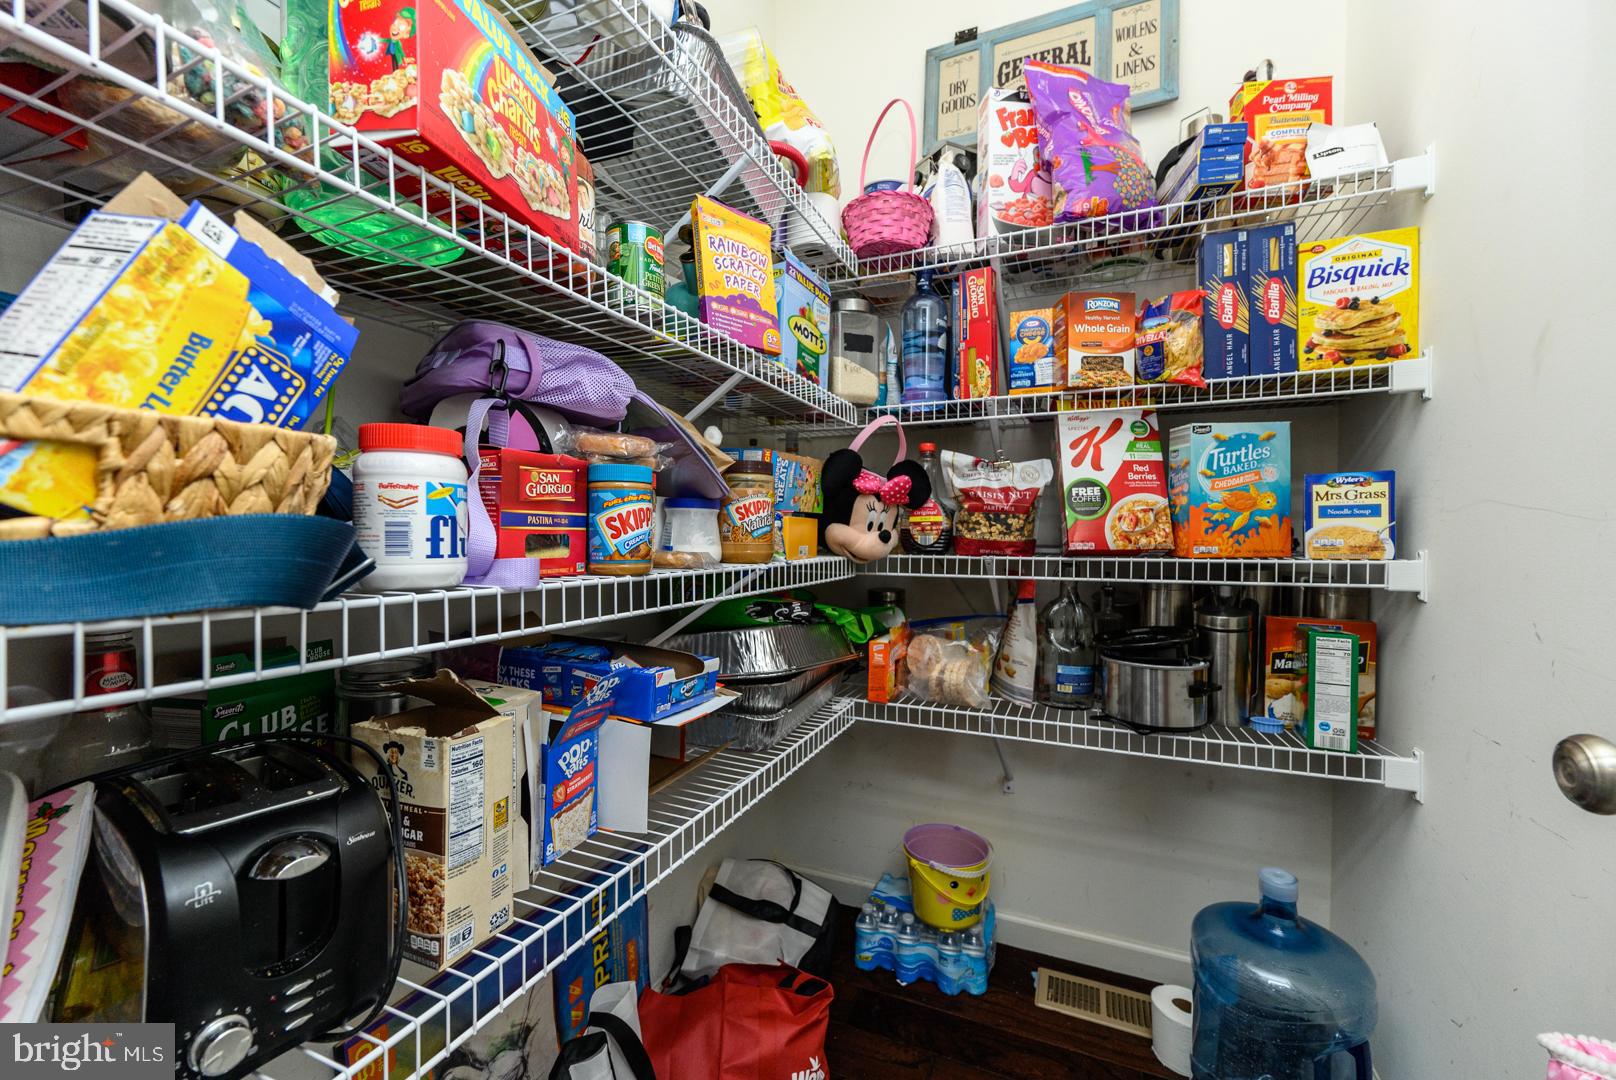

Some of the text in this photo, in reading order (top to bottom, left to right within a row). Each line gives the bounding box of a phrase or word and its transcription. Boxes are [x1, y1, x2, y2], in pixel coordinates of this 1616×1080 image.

[1115, 19, 1158, 43] WOOLENS
[1128, 42, 1143, 58] &
[997, 39, 1092, 88] GEERAL
[1116, 55, 1156, 79] LINENS
[517, 58, 550, 105] PACK
[949, 79, 968, 97] DRY
[941, 94, 976, 115] GOODS
[1263, 92, 1319, 105] Pearl Milling
[487, 77, 541, 154] Charms
[1269, 102, 1312, 113] Company
[1270, 115, 1312, 124] Buttermilk
[1314, 147, 1343, 158] Lipton
[708, 234, 769, 268] RAINBOW
[1335, 251, 1378, 262] ORIGINAL
[714, 256, 767, 286] SCRATCH
[1307, 256, 1410, 289] Bisquick
[724, 273, 761, 298] PAPER
[796, 271, 816, 293] VALUE
[815, 287, 830, 305] PACK
[1356, 284, 1379, 292] BAKING
[968, 275, 979, 318] GIORGIO
[977, 285, 985, 305] SAN
[1268, 282, 1280, 319] Barilla
[1087, 300, 1119, 310] RONZONI
[1222, 287, 1233, 324] Barilla
[793, 321, 824, 350] MOTT'S
[1074, 323, 1130, 334] Whole Grain
[157, 331, 213, 396] Butter
[1069, 417, 1124, 472] K
[1210, 443, 1271, 470] Turtles
[1128, 472, 1157, 480] Berries
[1133, 464, 1149, 472] Red
[1223, 461, 1258, 475] BAKED
[540, 472, 560, 484] SAN
[777, 459, 789, 503] TREATS
[1215, 477, 1243, 489] CHEDDAR
[525, 482, 572, 497] GIORGIO
[1008, 490, 1031, 500] NUT
[1072, 487, 1101, 496] FREE
[1344, 489, 1387, 501] Grass
[1072, 495, 1101, 503] COFFEE
[734, 499, 772, 522] SKIPPY
[527, 515, 553, 524] PASTINA
[624, 534, 647, 550] CREAMY
[509, 666, 536, 679] THESE
[451, 739, 483, 752] Nutrition Facts
[450, 760, 484, 776] Calories 160
[567, 772, 593, 794] STRAWBERRY
[403, 816, 410, 827] &
[546, 843, 553, 856] 8
